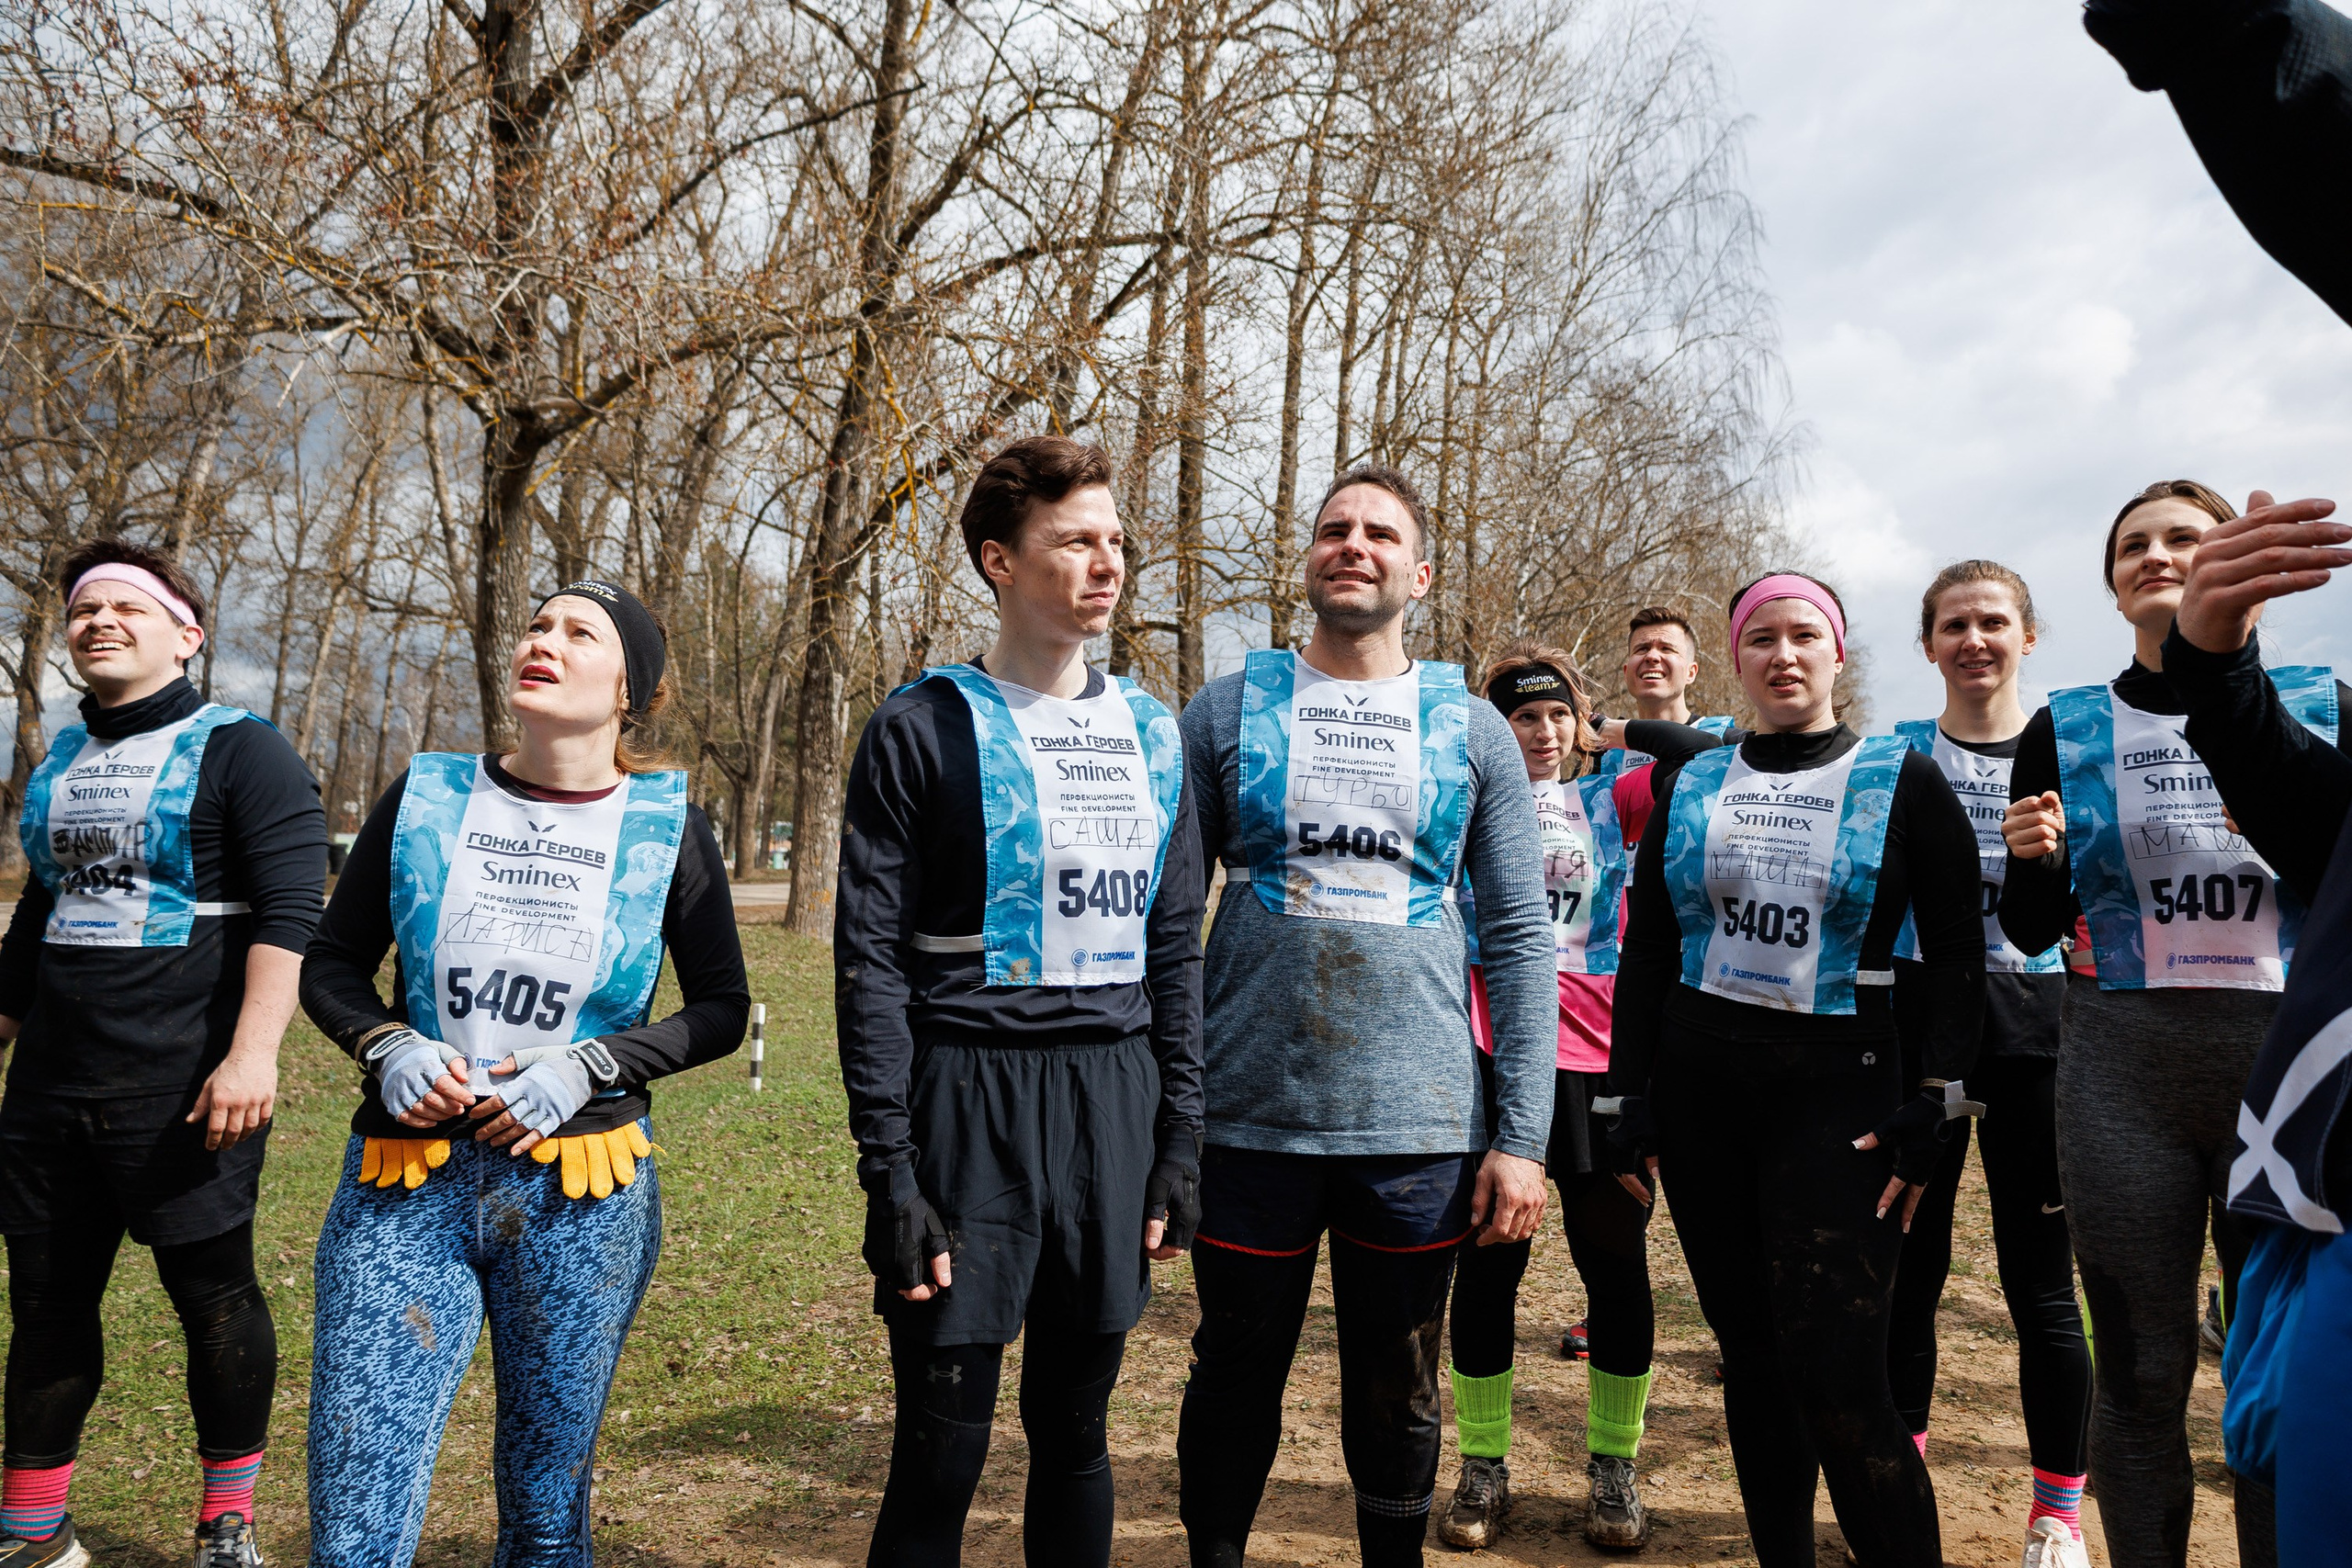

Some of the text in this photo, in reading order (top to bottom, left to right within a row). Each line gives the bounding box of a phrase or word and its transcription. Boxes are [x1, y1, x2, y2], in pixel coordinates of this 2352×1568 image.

[1517, 674, 1555, 687] Sminex
[1524, 682, 1551, 693] team
[1298, 707, 1411, 728] ГОНКА ГЕРОЕВ
[1030, 735, 1136, 750] ГОНКА ГЕРОЕВ
[1314, 728, 1396, 752] Sminex
[1312, 755, 1396, 769] ПЕРФЕКЦИОНИСТЫ
[1625, 755, 1651, 766] ГОНКА
[2123, 748, 2184, 766] ГОНКА
[67, 763, 155, 778] ГОНКА ГЕРОЕВ
[1057, 759, 1131, 781] Sminex
[1334, 767, 1395, 778] DEVELOPMENT
[1297, 773, 1409, 809] ТУРБО
[1950, 780, 2008, 794] НКА ГЕР
[2143, 773, 2212, 794] Smin
[68, 784, 133, 802] Sminex
[1060, 793, 1136, 802] ПЕРФЕКЦИОНИСТЫ
[1724, 793, 1835, 808] ГОНКА ГЕРОЕВ
[64, 807, 127, 817] ПЕРФЕКЦИОНИСТЫ
[1538, 802, 1580, 818] ГЕРОЕВ
[2145, 802, 2223, 812] ПЕРФЕКЦИОНИ
[1538, 818, 1571, 833] inex
[1732, 809, 1814, 831] Sminex
[2146, 815, 2168, 823] FINE
[1050, 816, 1148, 850] САША
[1298, 822, 1401, 862] 5406
[1728, 834, 1811, 847] ПЕРФЕКЦИОНИСТЫ
[2142, 823, 2254, 855] МАШ
[467, 832, 606, 863] ГОНКА ГЕРОЕВ
[1747, 844, 1809, 856] DEVELOPMENT
[1546, 849, 1588, 881] ТЯ
[1713, 845, 1815, 886] МАША
[481, 861, 581, 892] Sminex
[475, 891, 578, 910] ПЕРФЕКЦИОНИСТЫ
[1058, 868, 1148, 918] 5408
[1327, 886, 1388, 900] ГАЗПРОМБАНК
[2150, 874, 2263, 925] 5407
[474, 902, 576, 922] FINE DEVELOPMENT
[1546, 889, 1581, 924] 97
[68, 920, 119, 929] ГАЗПРОМБАНК
[1722, 897, 1810, 949] 5403
[435, 908, 592, 960] ЛАРИСА
[1091, 950, 1136, 962] ГАЗПРОМБАНК
[2177, 955, 2256, 966] ГАЗПРОМБАНК
[1731, 968, 1791, 986] ГАЗПРОМБАНК
[447, 967, 571, 1032] 5405
